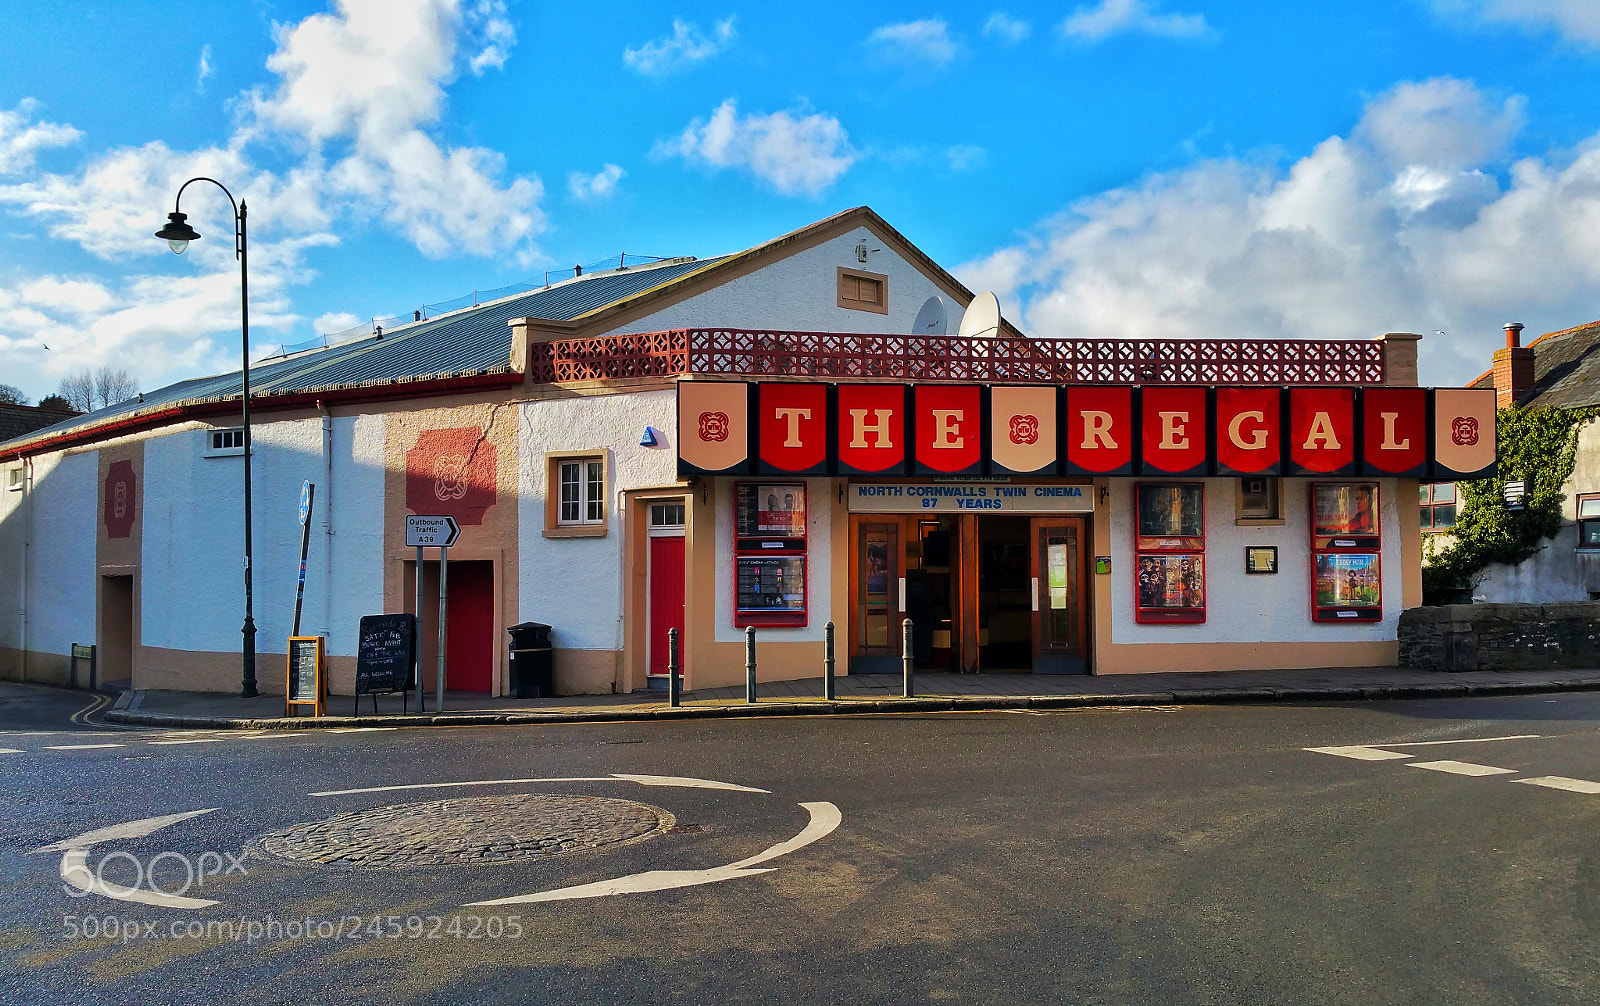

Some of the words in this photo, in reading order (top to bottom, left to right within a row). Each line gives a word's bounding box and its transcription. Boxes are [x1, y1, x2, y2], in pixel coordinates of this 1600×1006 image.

[775, 407, 965, 450] THE
[1080, 410, 1410, 451] REGAL
[858, 486, 903, 497] NORTH
[906, 486, 987, 497] CORNWALLS
[994, 487, 1027, 498] TWIN
[1034, 487, 1083, 498] CINEMA
[921, 498, 938, 508] 87
[956, 498, 1002, 509] YEARS
